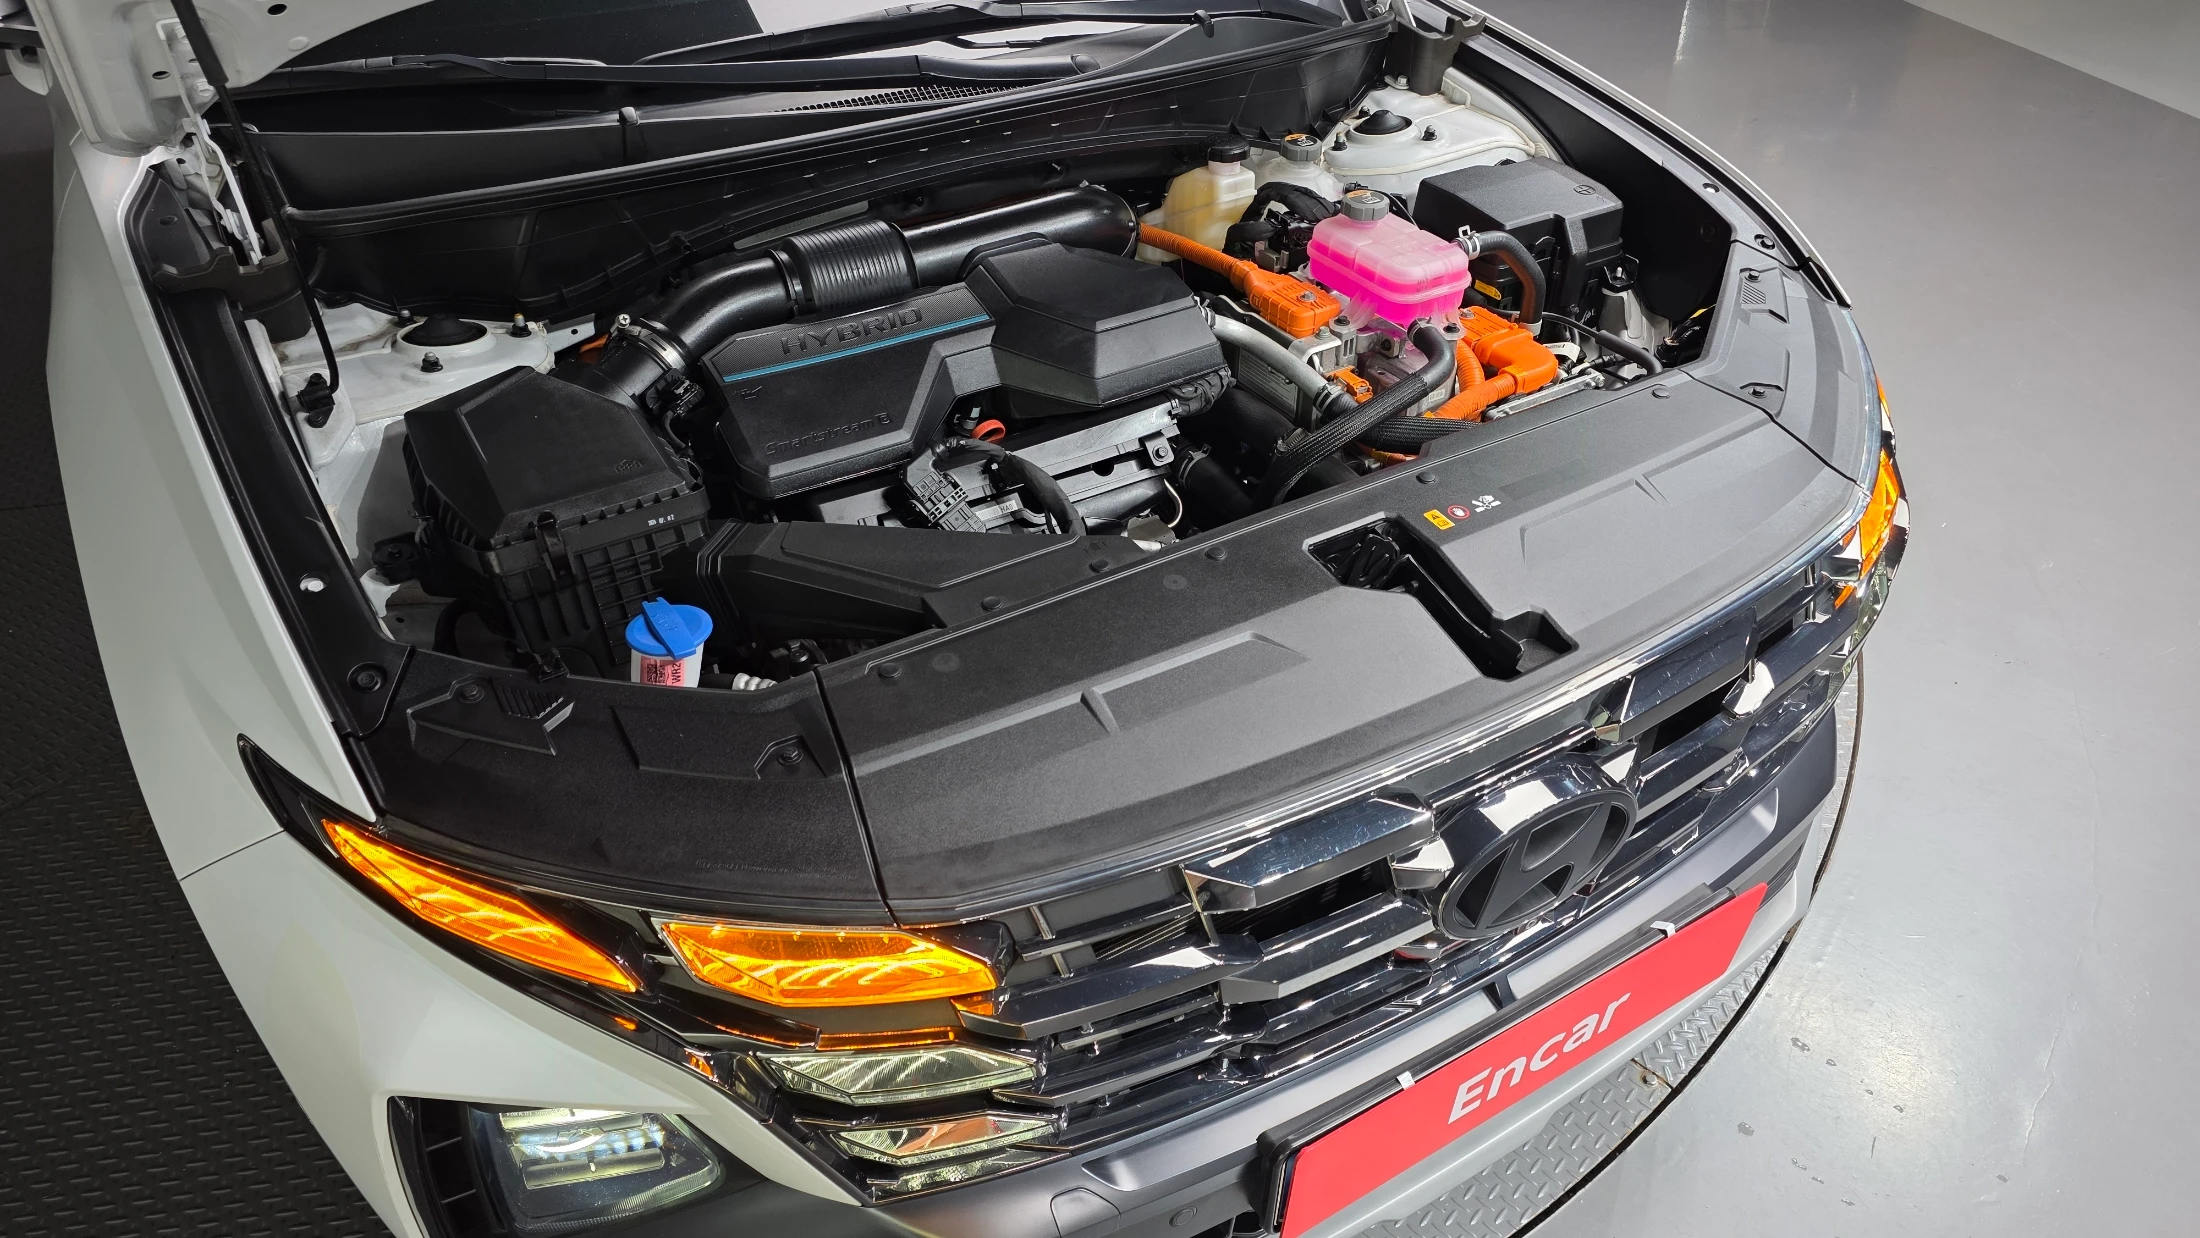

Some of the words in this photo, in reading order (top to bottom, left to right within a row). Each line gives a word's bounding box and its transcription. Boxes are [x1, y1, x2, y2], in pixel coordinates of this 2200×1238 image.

[780, 307, 923, 355] HYBRID
[766, 418, 876, 455] Smartstream
[672, 662, 682, 684] WR2
[1447, 992, 1631, 1124] Encar
